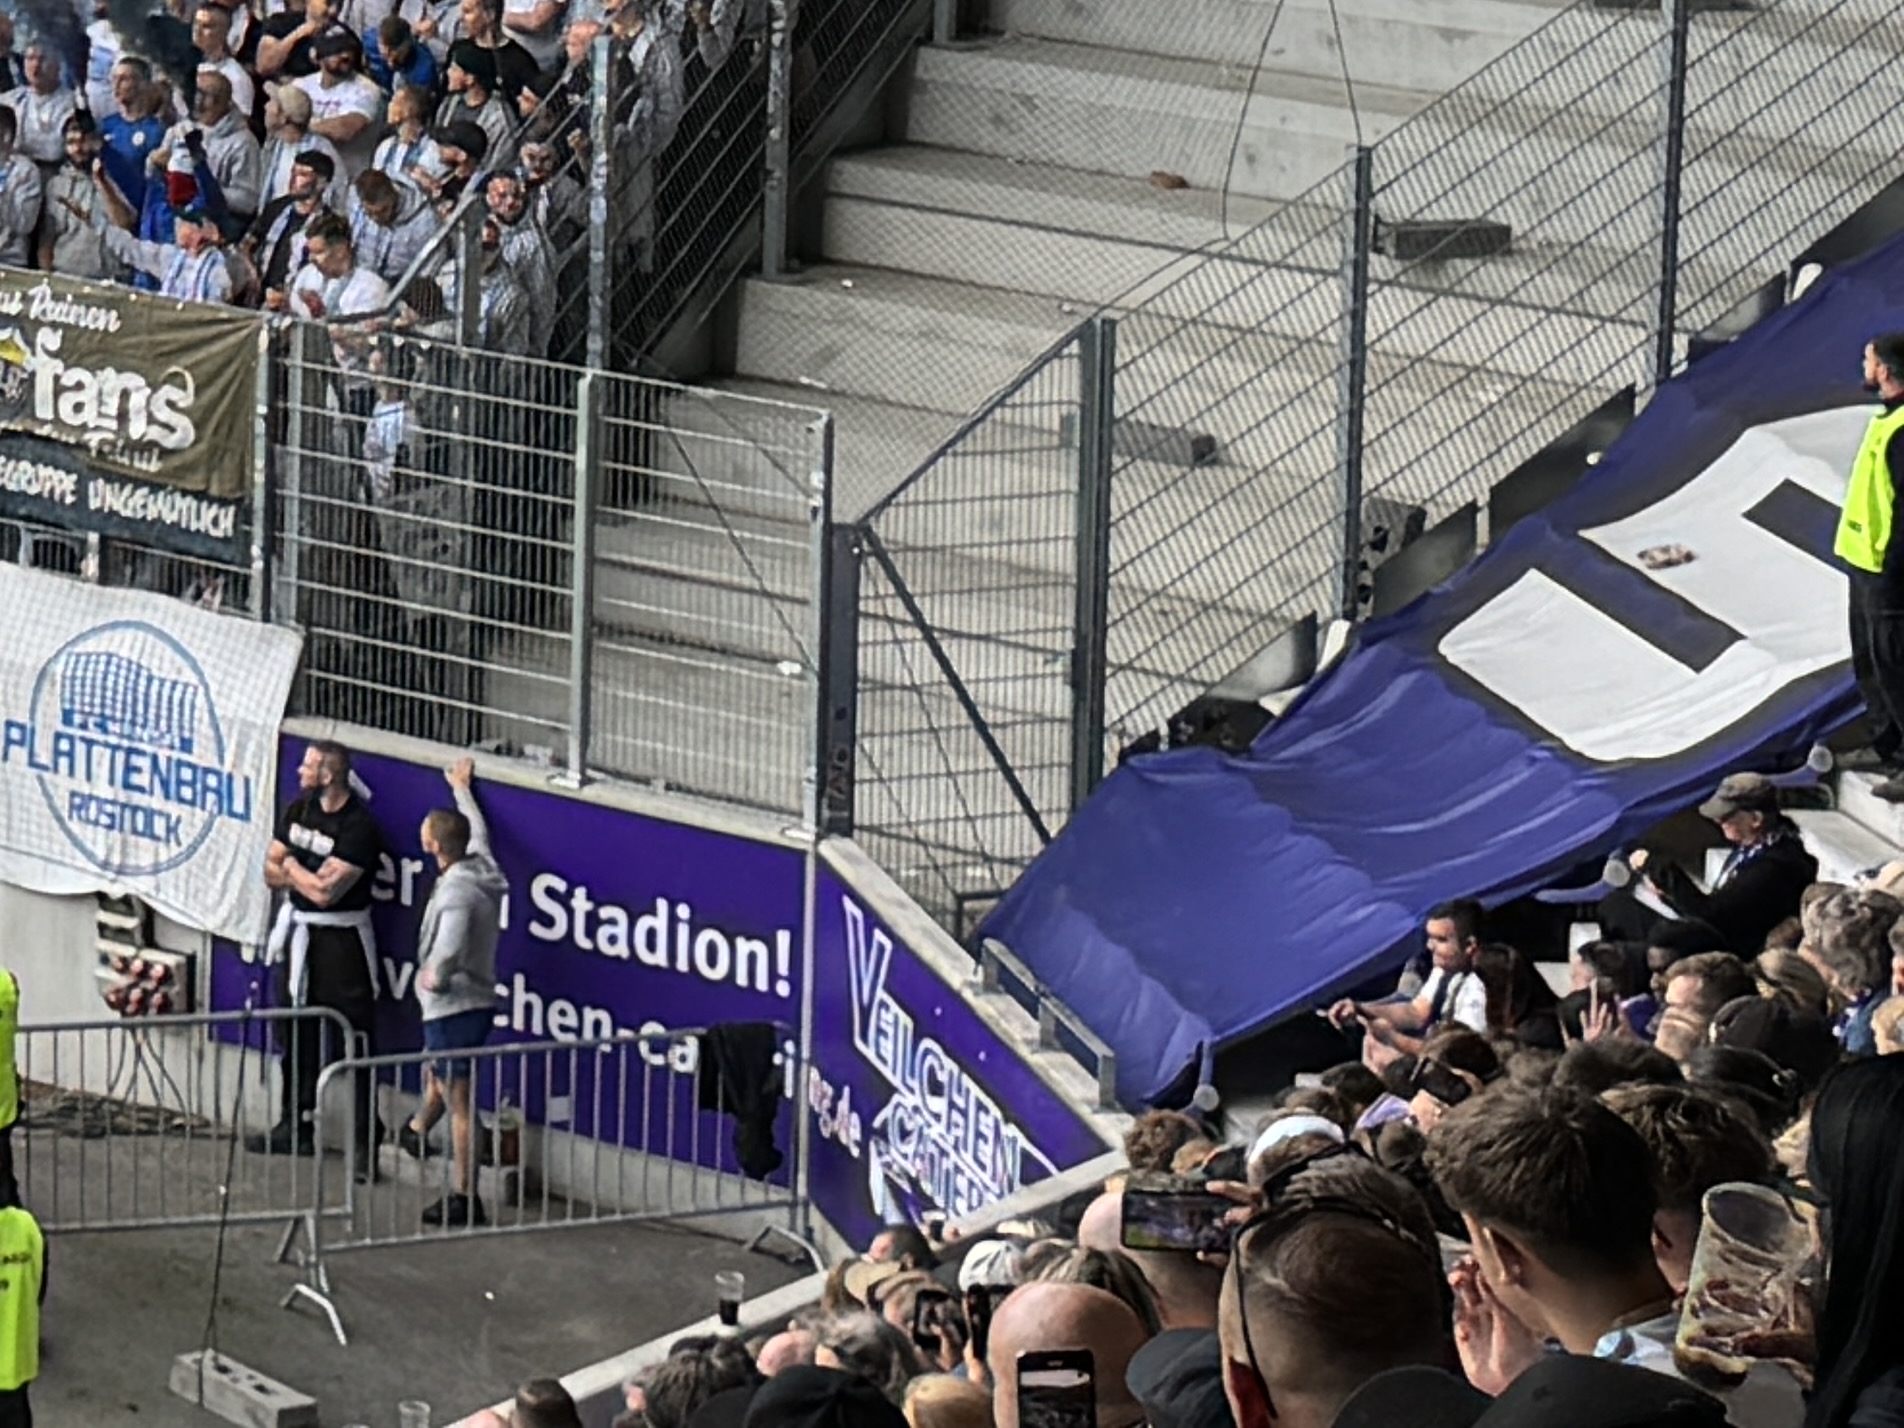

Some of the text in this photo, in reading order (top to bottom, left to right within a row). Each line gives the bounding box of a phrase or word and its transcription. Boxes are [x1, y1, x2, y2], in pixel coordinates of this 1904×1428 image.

[27, 276, 122, 332] Ruinen
[32, 326, 197, 450] fans
[0, 718, 254, 823] PLATTENBAU
[68, 790, 183, 846] ROSTOCK
[528, 872, 792, 999] Stadion!
[842, 894, 1022, 1202] VEILCHEN
